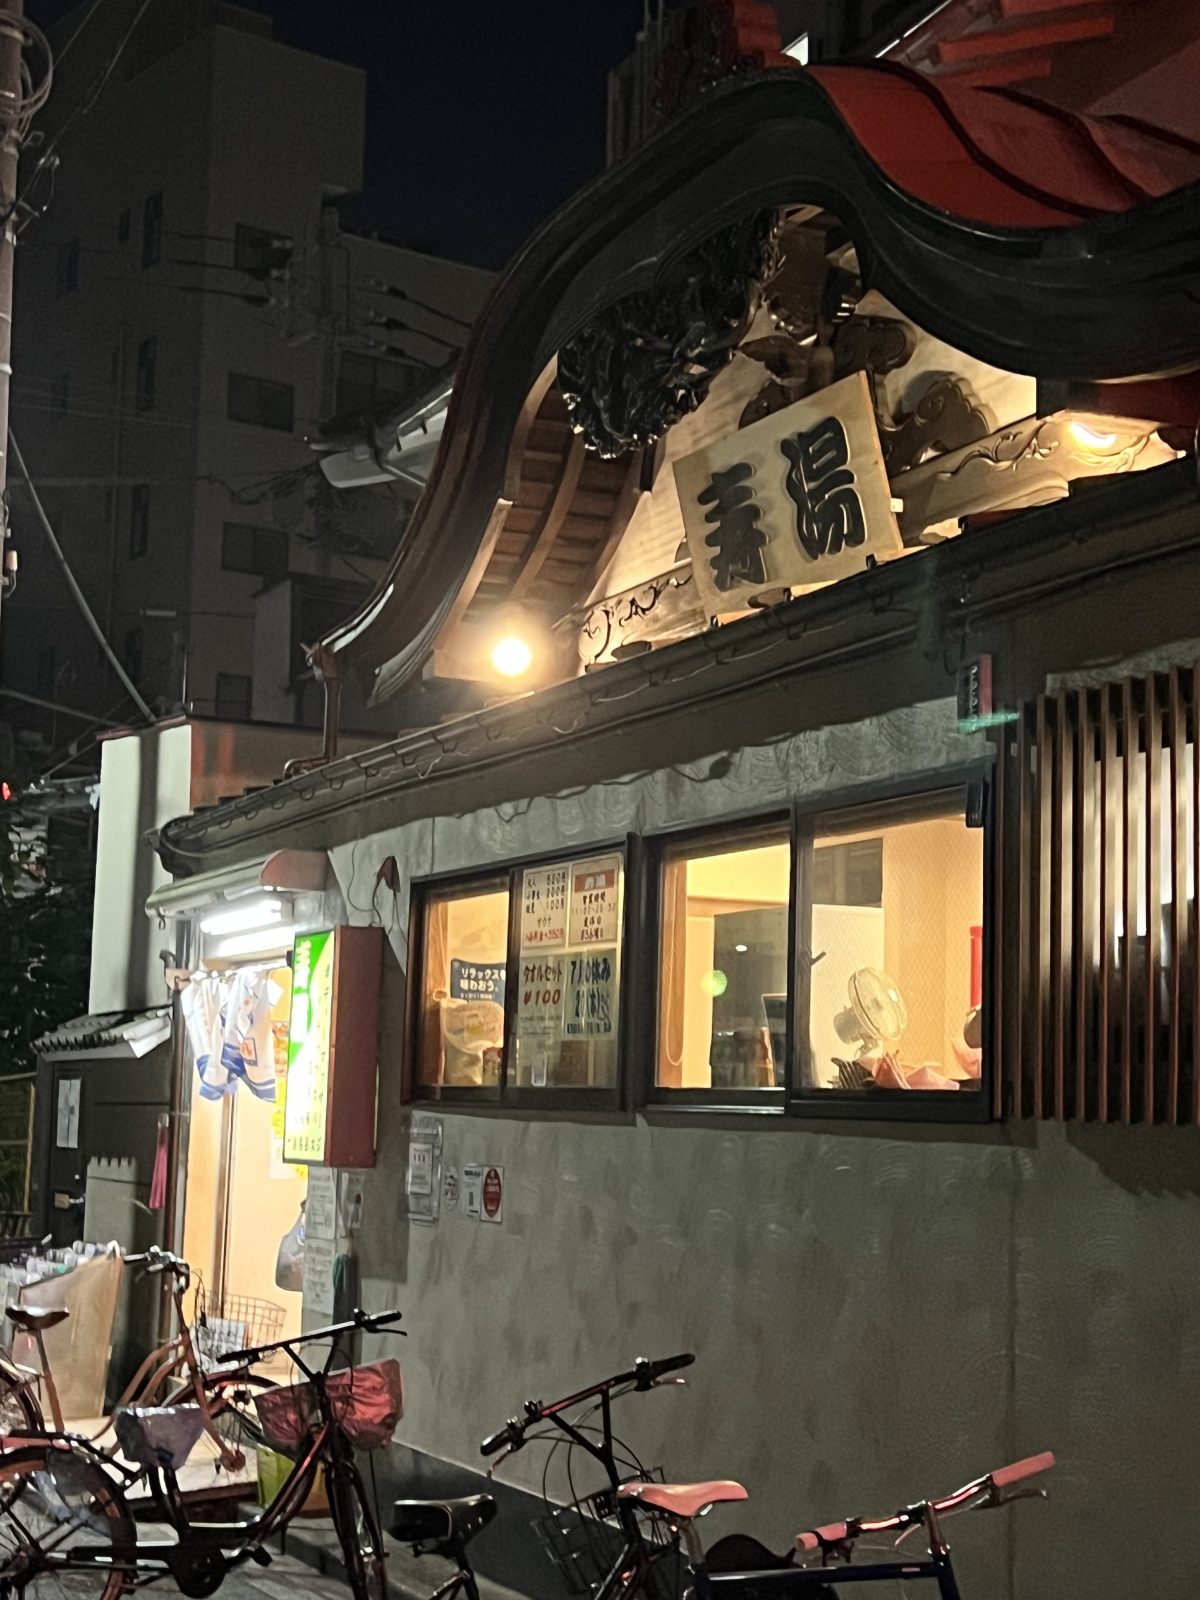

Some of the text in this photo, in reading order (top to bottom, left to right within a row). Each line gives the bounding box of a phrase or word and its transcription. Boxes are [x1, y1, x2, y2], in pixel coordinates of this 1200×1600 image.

[523, 960, 563, 985] タオルセット
